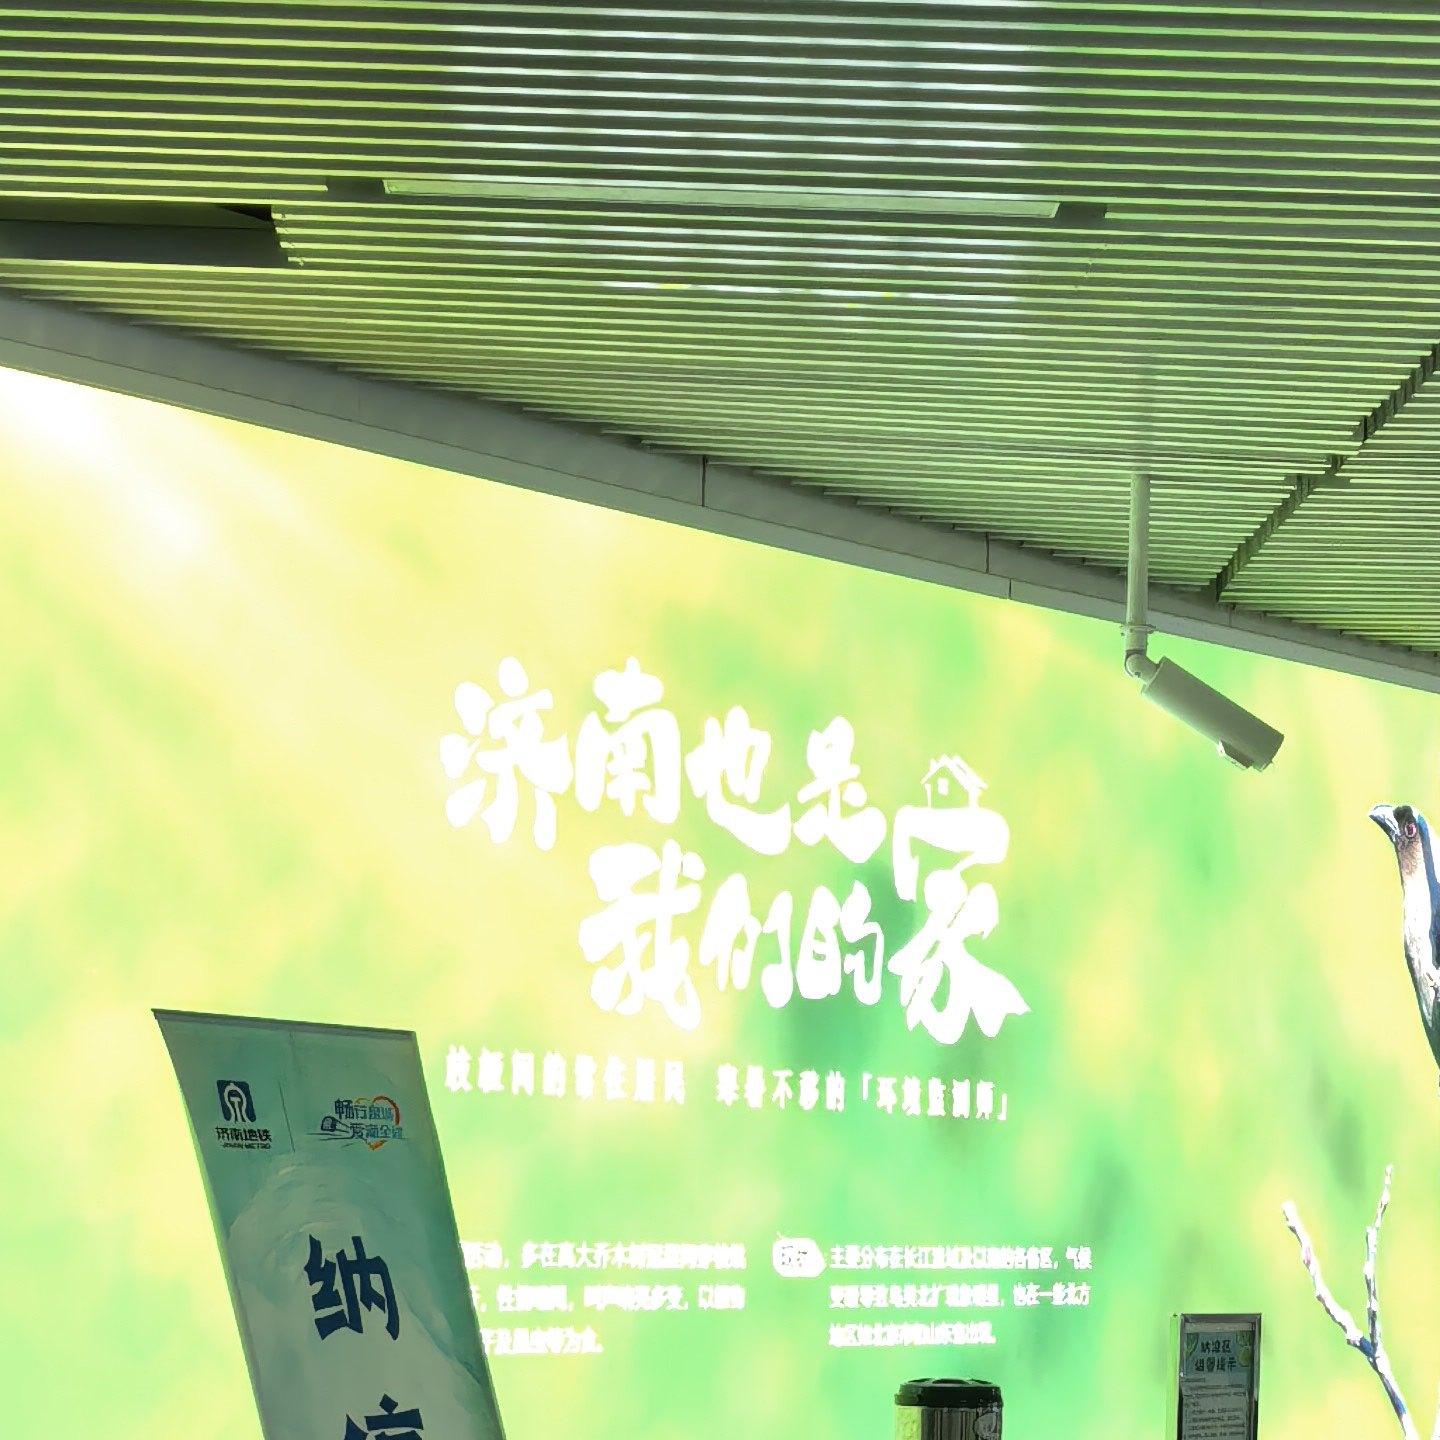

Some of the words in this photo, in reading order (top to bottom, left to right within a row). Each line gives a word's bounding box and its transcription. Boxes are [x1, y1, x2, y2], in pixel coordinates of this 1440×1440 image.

[439, 655, 887, 863] 济南也是
[578, 755, 1031, 1044] 我们的家
